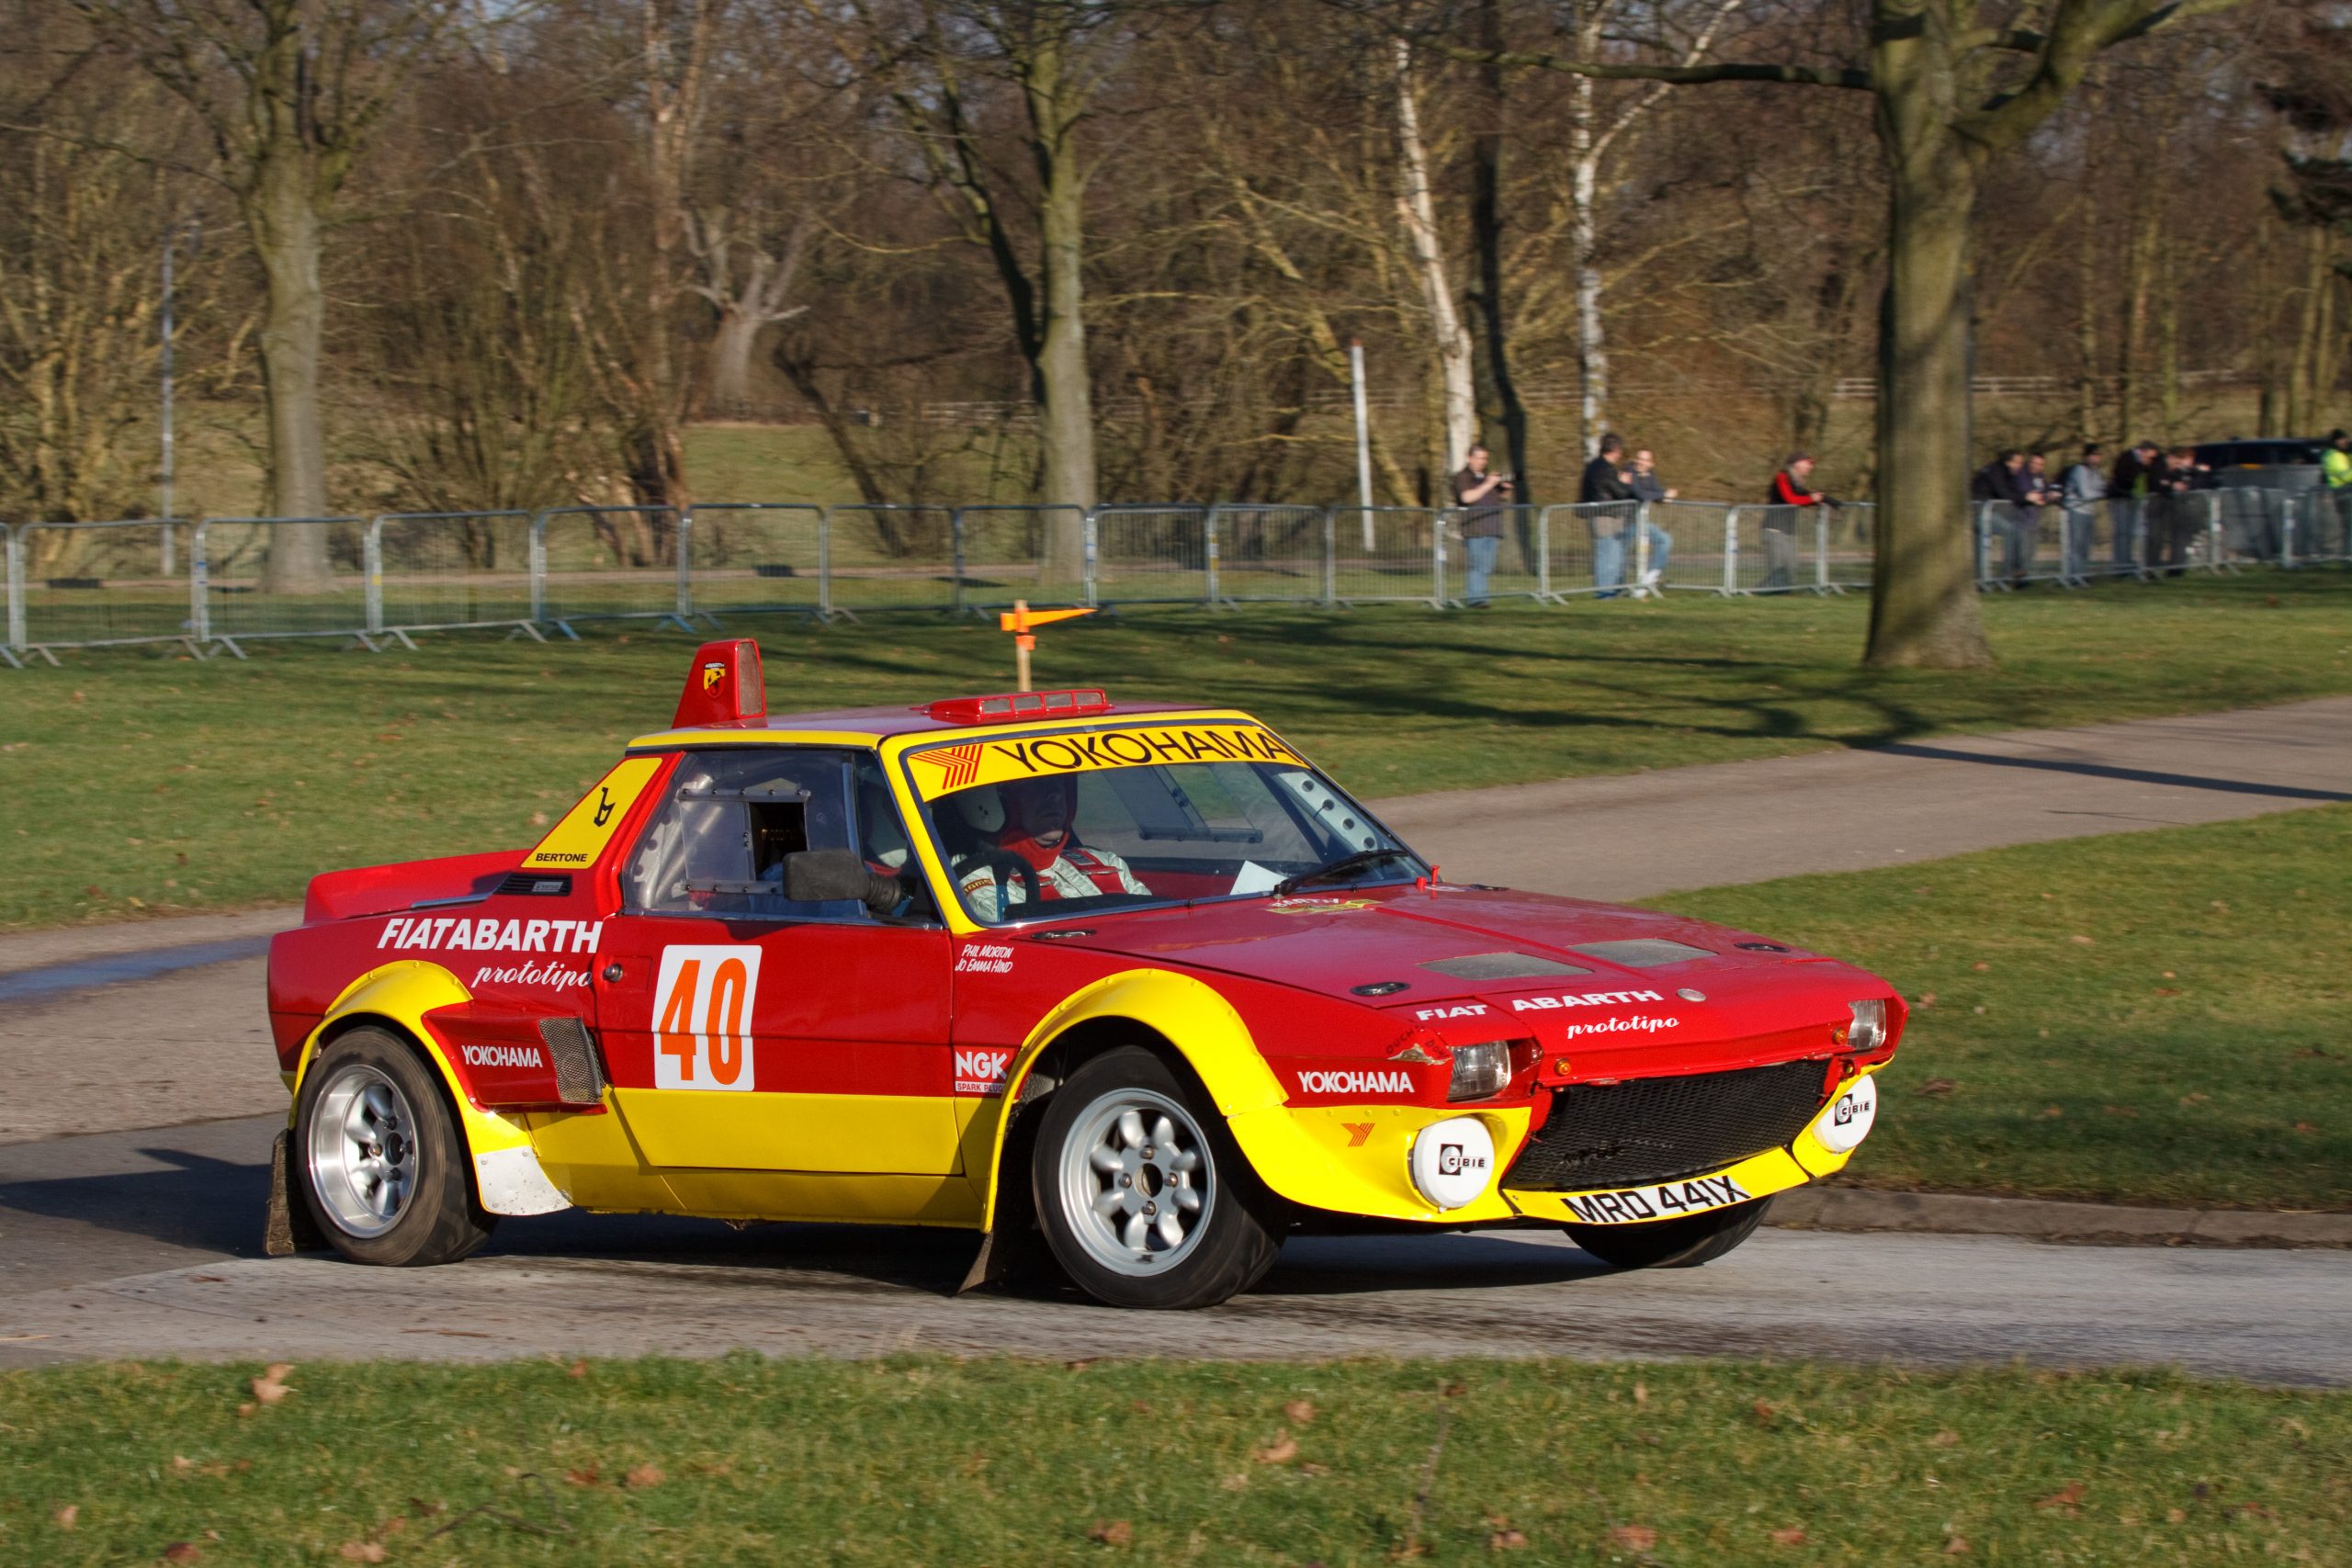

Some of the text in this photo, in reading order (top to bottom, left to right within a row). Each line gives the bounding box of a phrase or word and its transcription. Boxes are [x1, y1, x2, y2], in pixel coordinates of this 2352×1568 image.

[991, 730, 1302, 773] YOKOHAMA
[535, 852, 588, 862] BERTONE
[961, 943, 1014, 958] PHIL MORTON
[470, 960, 593, 992] prototipo
[955, 958, 1013, 973] JO EMMA HIND
[1416, 990, 1665, 1021] FIAT ABARTH
[659, 957, 747, 1086] 40
[1566, 1015, 1680, 1039] prototipo
[461, 1044, 543, 1067] YOKOHAMA
[956, 1051, 1007, 1079] NGK
[957, 1083, 1004, 1093] SPARK PLUG
[1296, 1071, 1415, 1093] YOKOHAMA
[1560, 1175, 1751, 1224] MRD 441X
